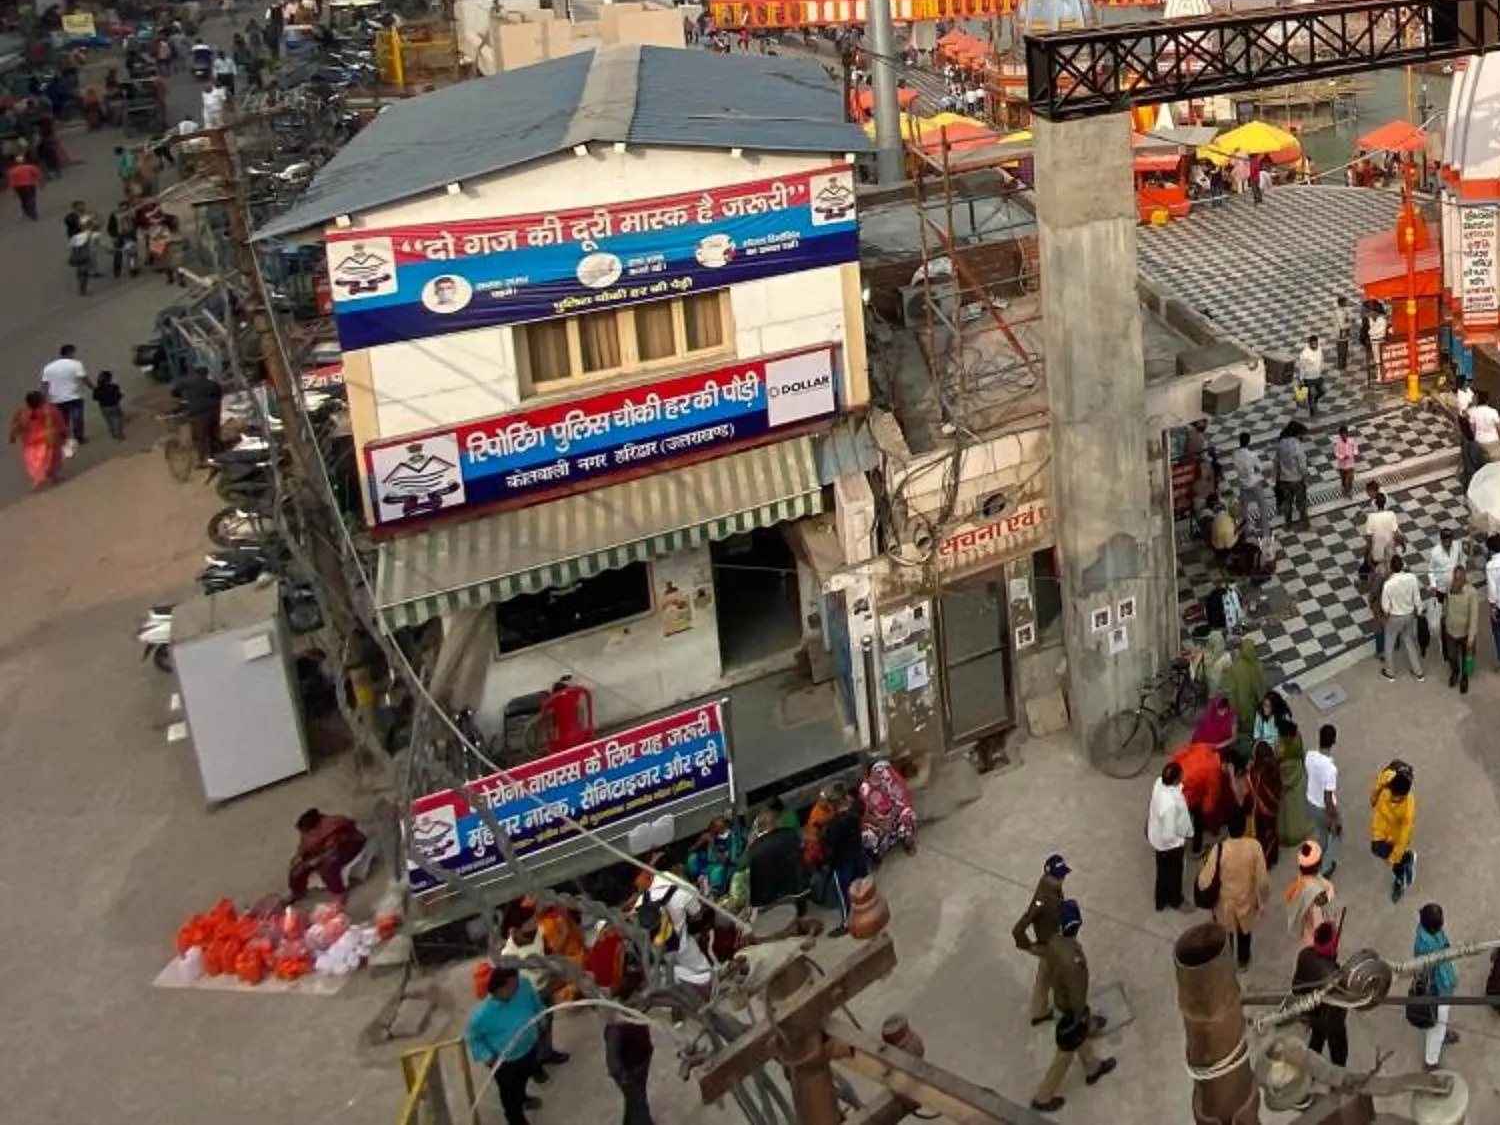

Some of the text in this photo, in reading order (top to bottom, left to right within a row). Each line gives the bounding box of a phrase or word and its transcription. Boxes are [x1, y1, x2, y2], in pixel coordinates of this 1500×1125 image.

[463, 230, 518, 255] गज
[525, 214, 563, 246] की
[570, 208, 613, 252] दूरी
[619, 204, 691, 233] मास्क
[695, 192, 714, 224] है
[781, 375, 830, 395] DOLLAR
[551, 409, 611, 452] पुलिस
[612, 392, 661, 427] चौकी
[663, 394, 692, 420] हर
[692, 380, 719, 409] की
[722, 371, 760, 408] पौड़ी
[505, 458, 570, 488] कोतवाली
[577, 453, 608, 472] नगर
[1006, 505, 1036, 532] एवं
[527, 760, 581, 795] वायरस
[584, 747, 602, 776] के
[605, 740, 635, 769] लिए
[639, 733, 663, 757] यह
[666, 711, 711, 747] जरूरी
[663, 750, 692, 780] और
[693, 739, 719, 778] दूरी
